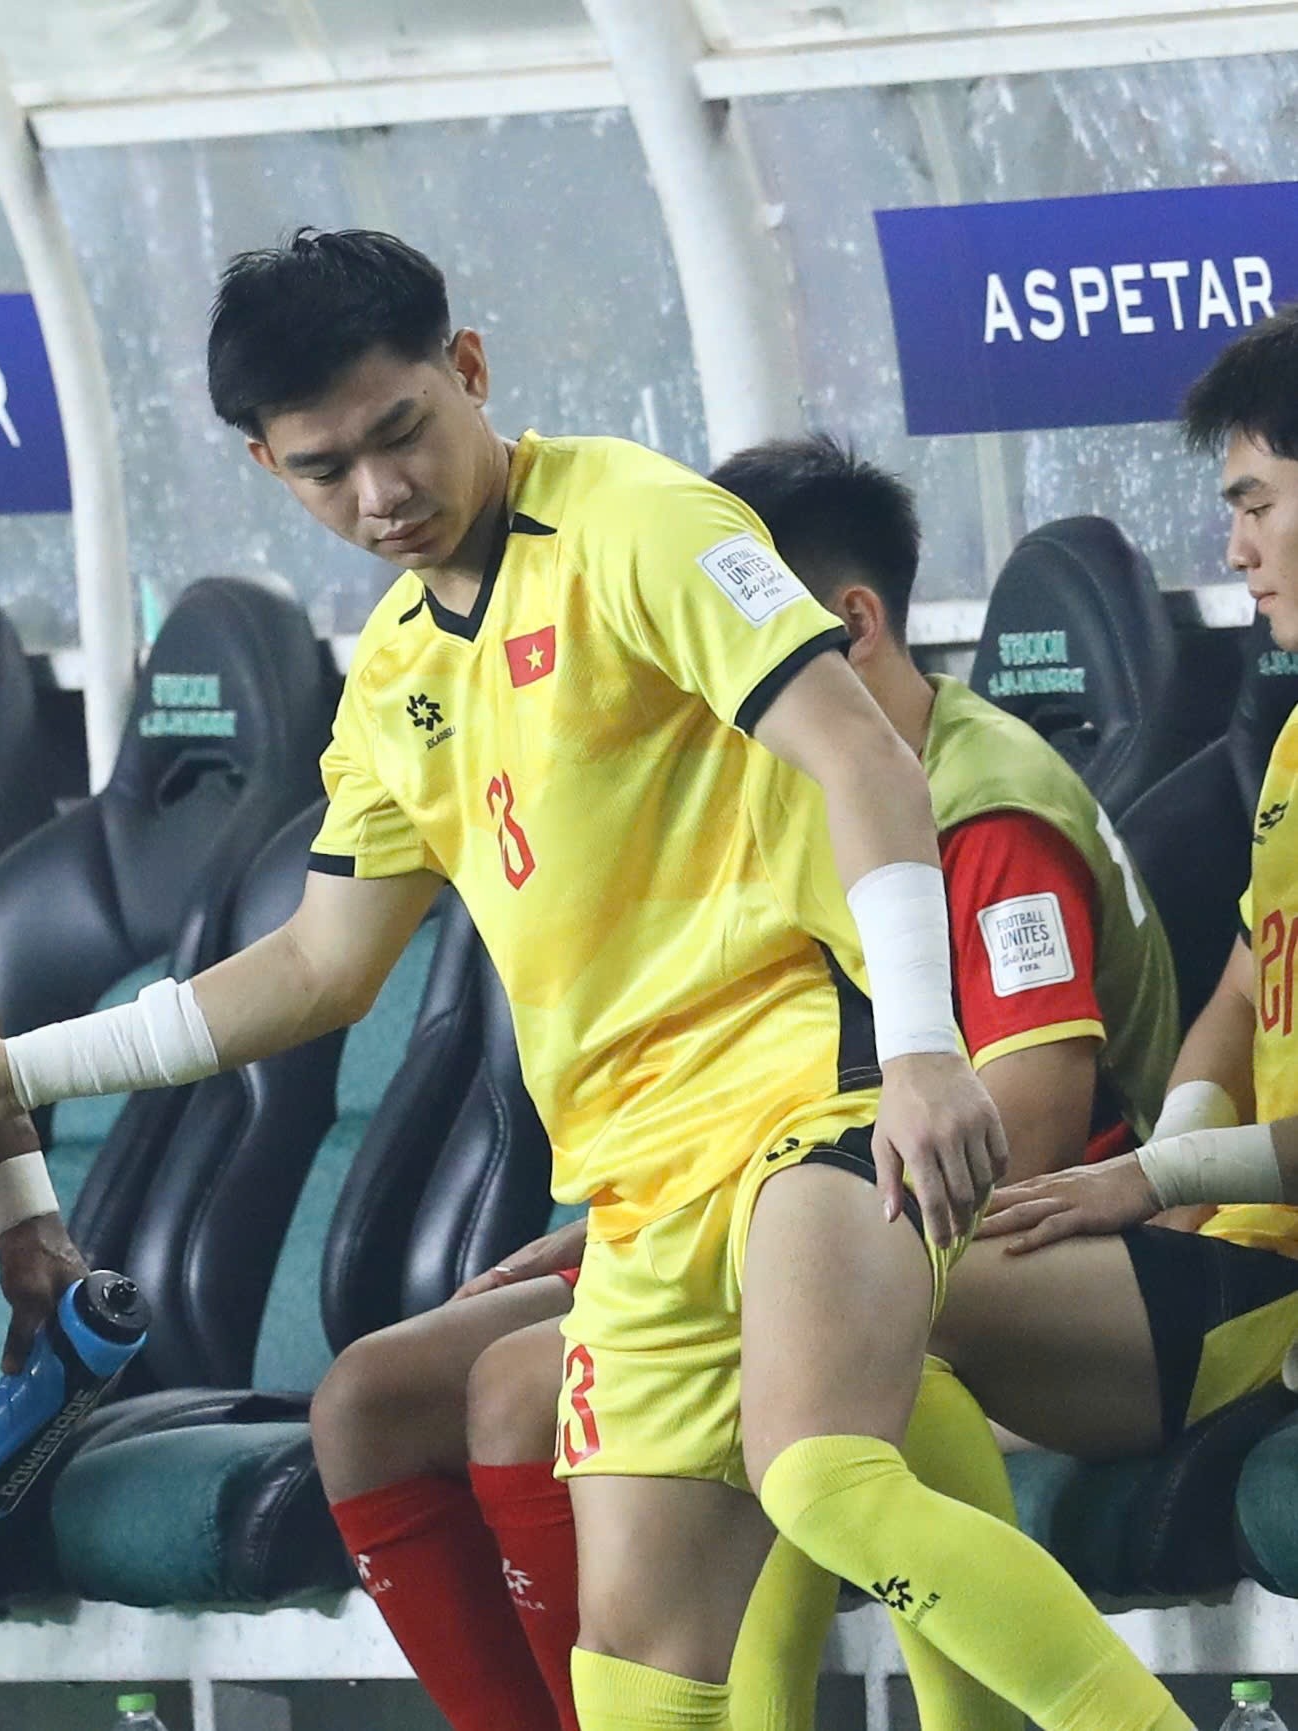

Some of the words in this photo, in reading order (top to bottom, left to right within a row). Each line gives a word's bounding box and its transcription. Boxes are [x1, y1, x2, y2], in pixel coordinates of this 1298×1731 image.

[984, 256, 1276, 343] ASPETAR
[1000, 924, 1050, 950] UNITES
[0, 1389, 97, 1497] POWERADE
